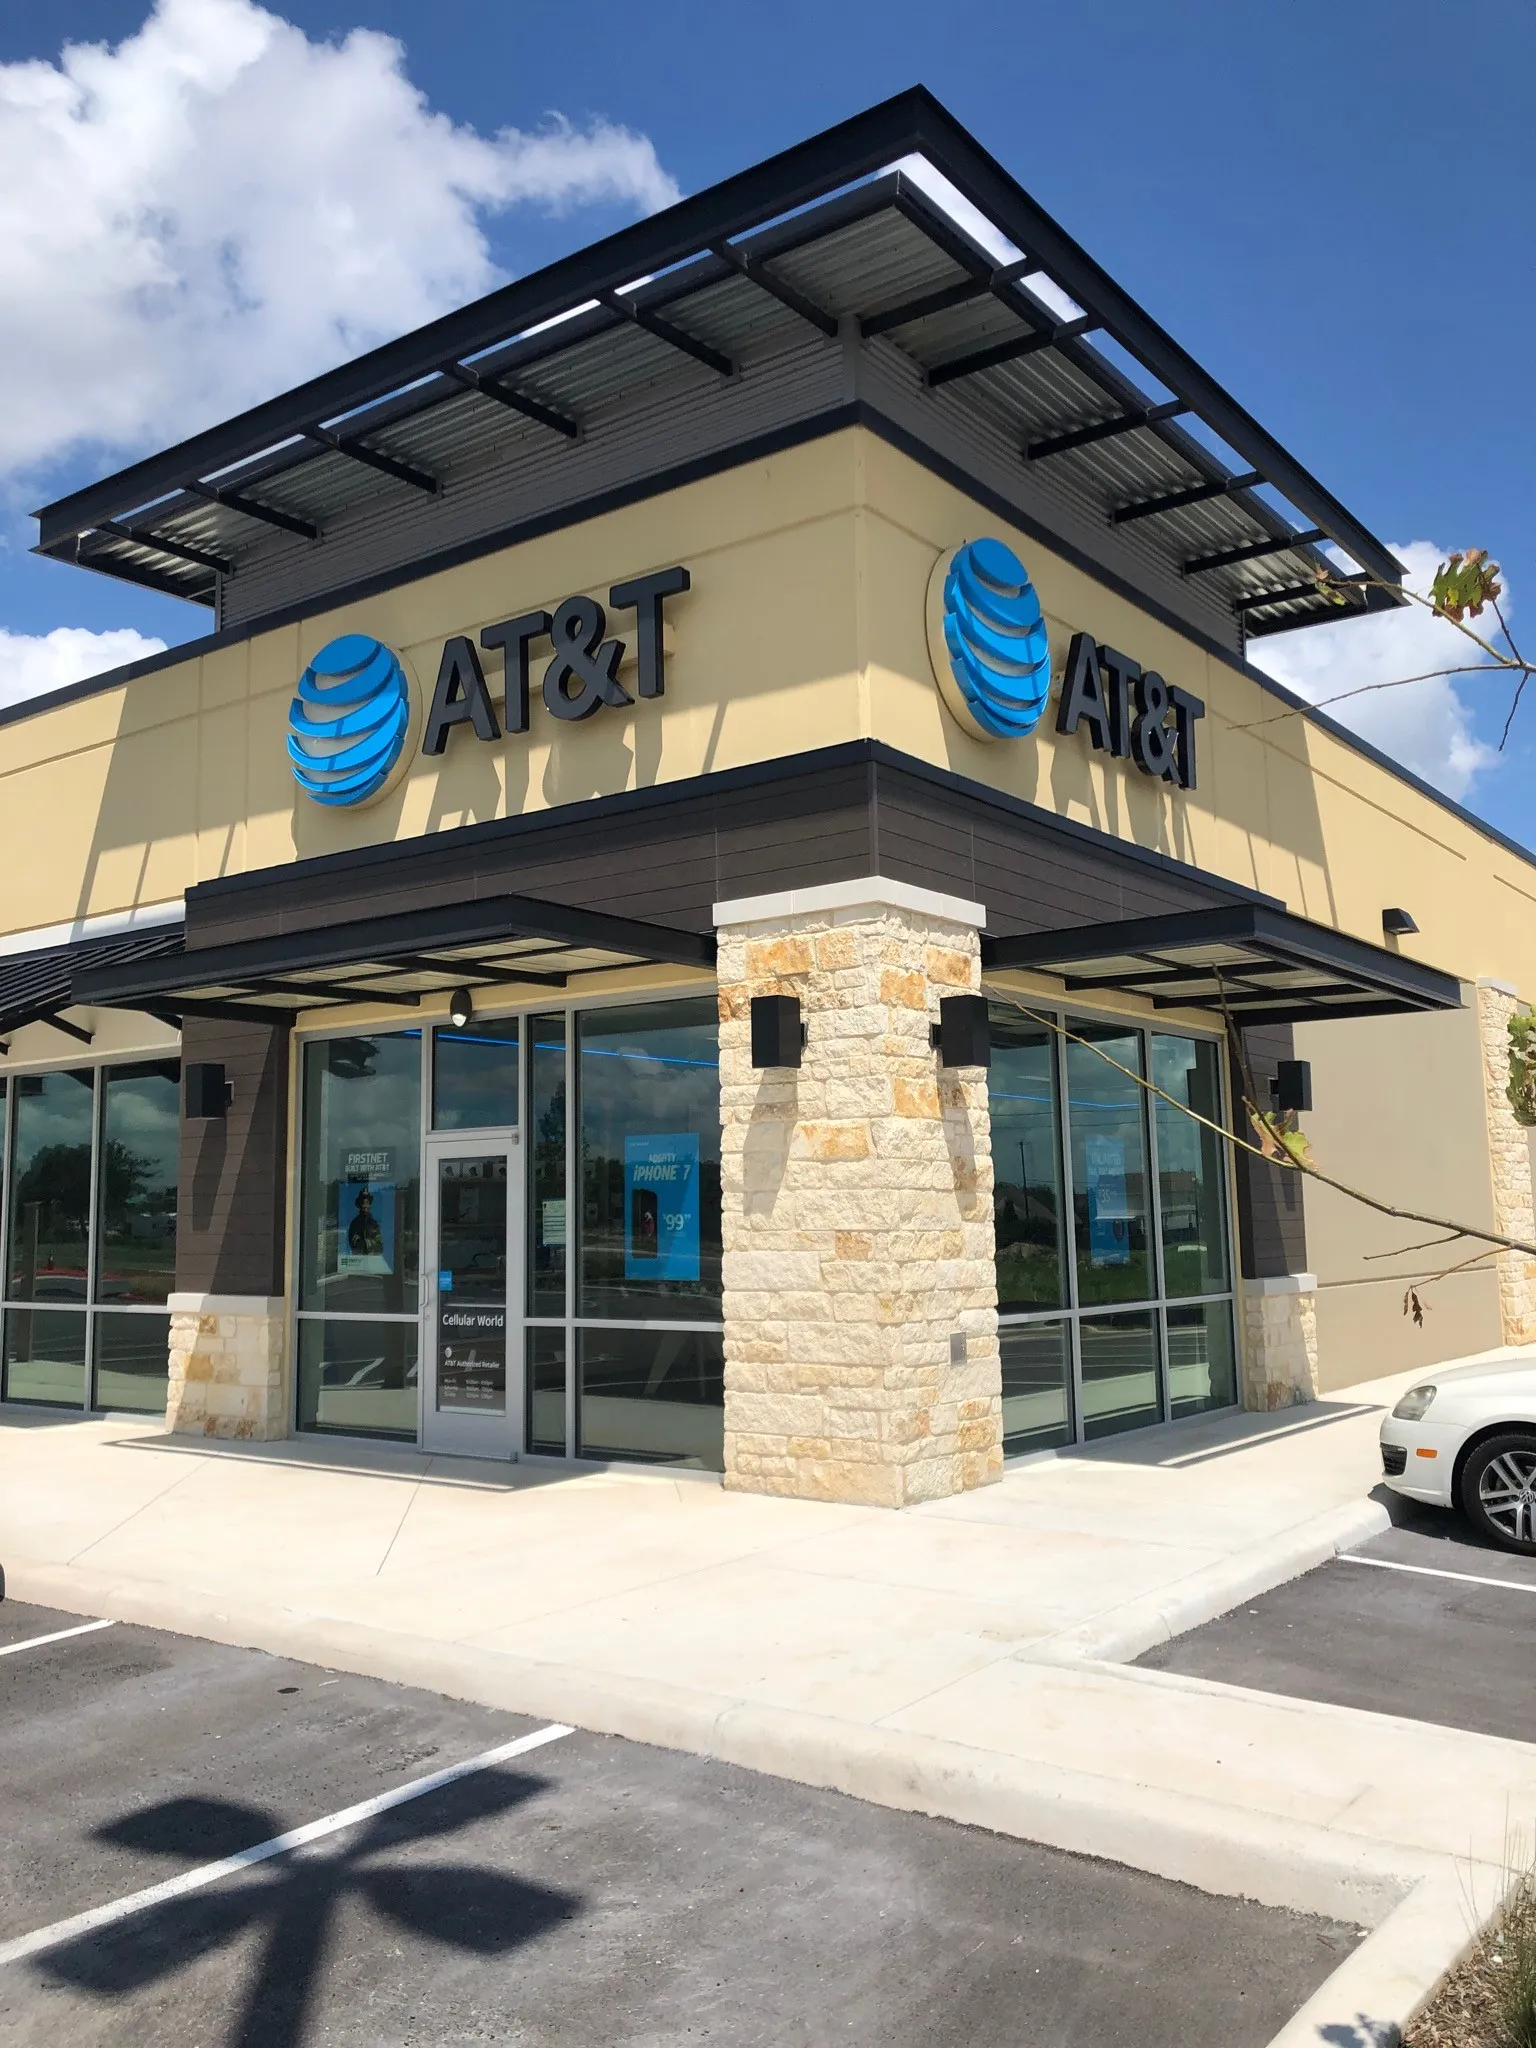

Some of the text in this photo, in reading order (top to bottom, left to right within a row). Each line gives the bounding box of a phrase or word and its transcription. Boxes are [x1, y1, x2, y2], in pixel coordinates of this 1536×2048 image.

[422, 566, 691, 756] AT&T
[1055, 631, 1205, 790] AT&T
[348, 1152, 388, 1165] FIRSTNET
[633, 1164, 692, 1182] iPHONE 7
[442, 1313, 504, 1327] Cellular World
